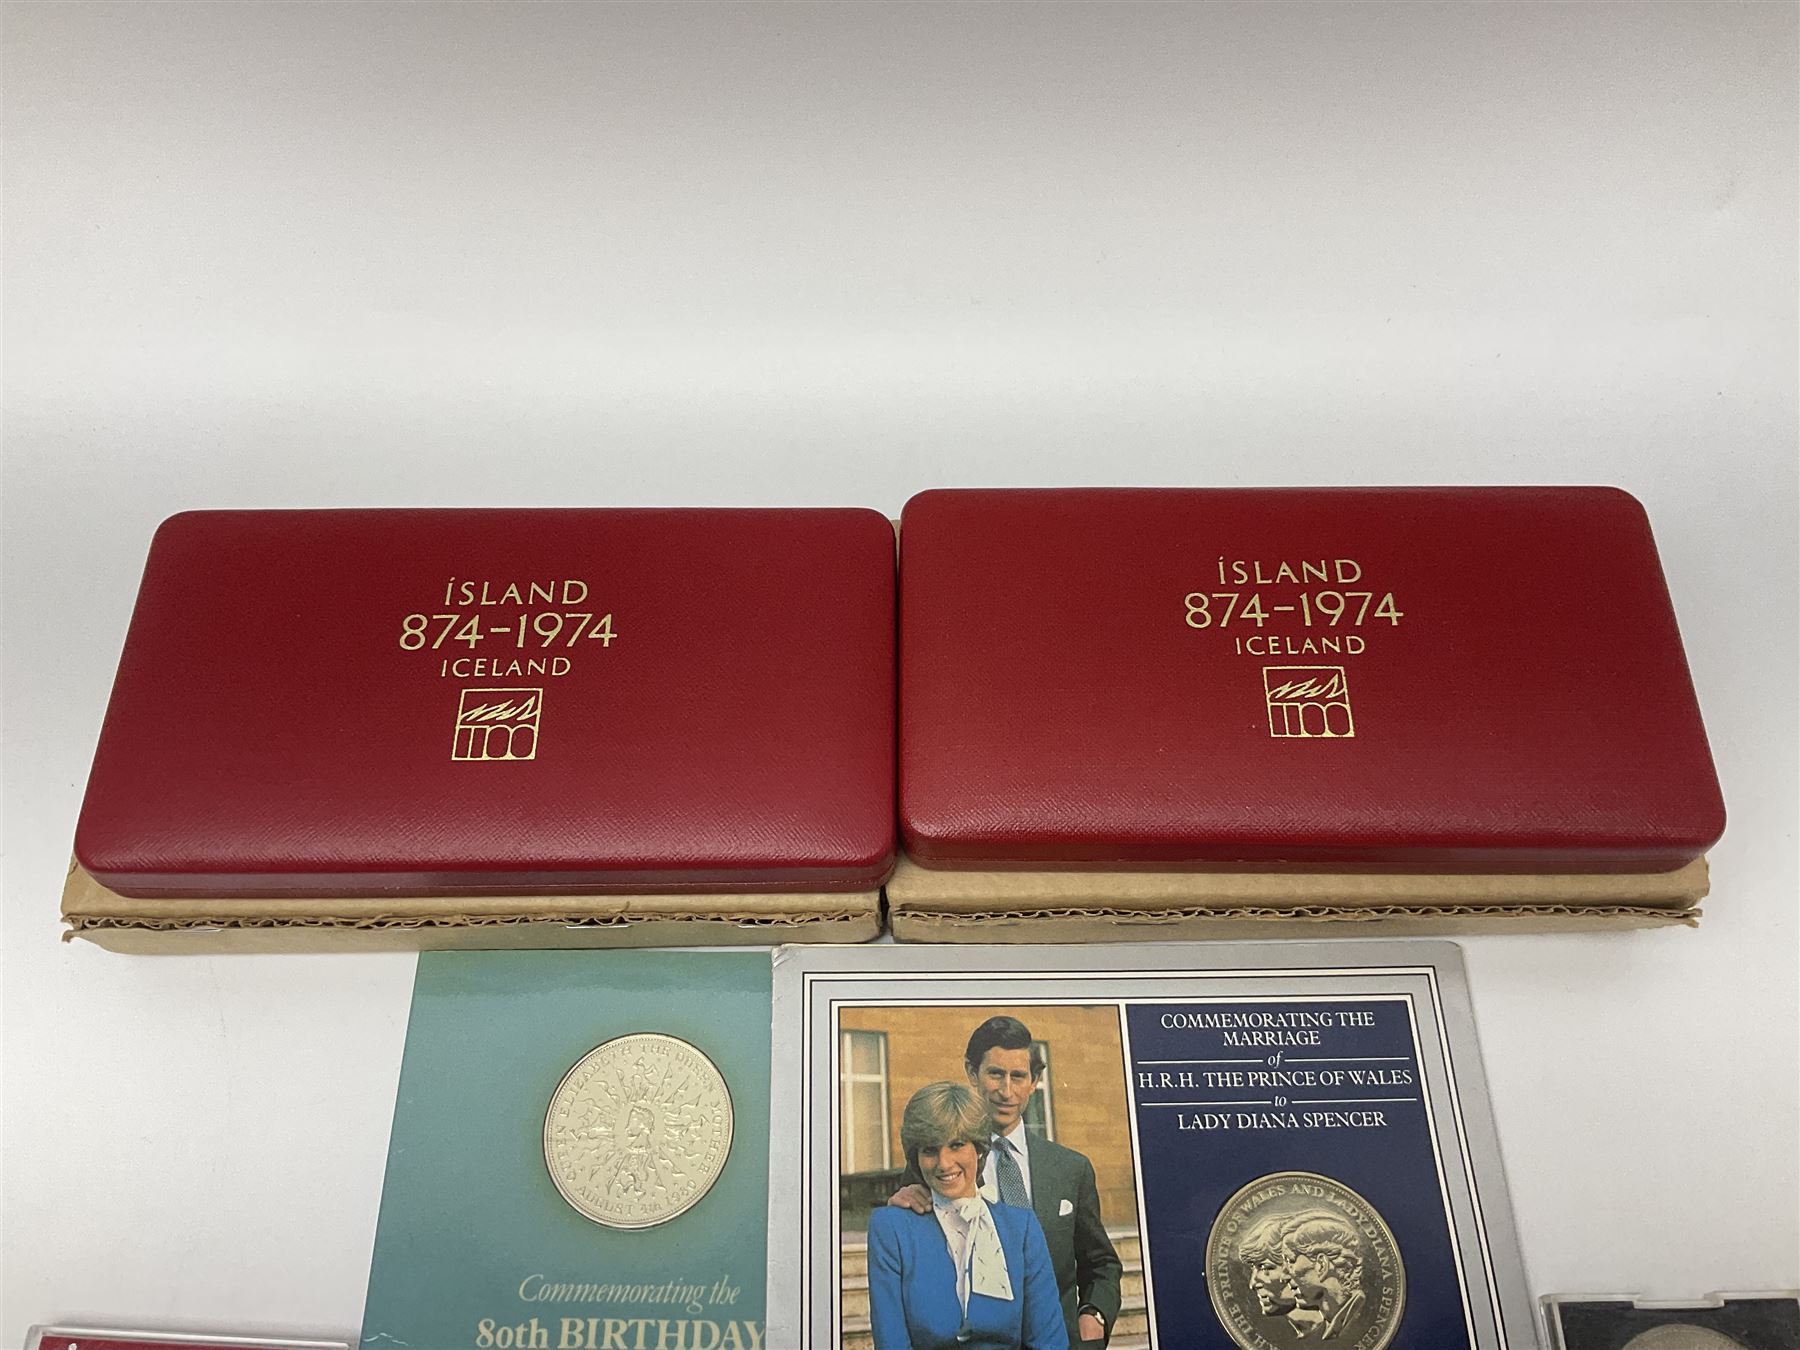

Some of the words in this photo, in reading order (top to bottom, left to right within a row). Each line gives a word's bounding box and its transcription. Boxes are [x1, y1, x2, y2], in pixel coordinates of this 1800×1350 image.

[1218, 556, 1362, 585] ÍSLAND
[444, 577, 589, 606] ÍSLAND
[1184, 590, 1404, 629] 874-1974
[399, 612, 618, 651] 874-1974
[1235, 636, 1366, 655] ICELAND
[440, 657, 572, 678] ICELAND
[1160, 1012, 1333, 1029] COMMEMORATING
[1335, 1011, 1375, 1027] THE
[1223, 1030, 1321, 1046] MARRIAGE
[640, 1043, 672, 1058] THE
[1267, 1051, 1284, 1069] of
[1139, 1072, 1199, 1088] H.R.H.
[1203, 1071, 1244, 1088] THE
[1248, 1070, 1317, 1087] PRINCE
[1319, 1070, 1348, 1086] OF
[1349, 1069, 1413, 1085] WALES
[1274, 1095, 1287, 1108] to
[1178, 1114, 1231, 1130] LADY
[1237, 1113, 1300, 1129] DIANA
[1303, 1111, 1388, 1128] SPENCER
[1218, 1236, 1234, 1300] PRINCE
[1226, 1212, 1243, 1233] OF
[1240, 1184, 1286, 1213] WALES
[1290, 1183, 1325, 1198] AND
[1326, 1191, 1369, 1227] LADY
[518, 1273, 706, 1315] Commemorating
[708, 1274, 741, 1305] the
[475, 1317, 549, 1349] 80th
[557, 1317, 765, 1350] BIRTHDAY
